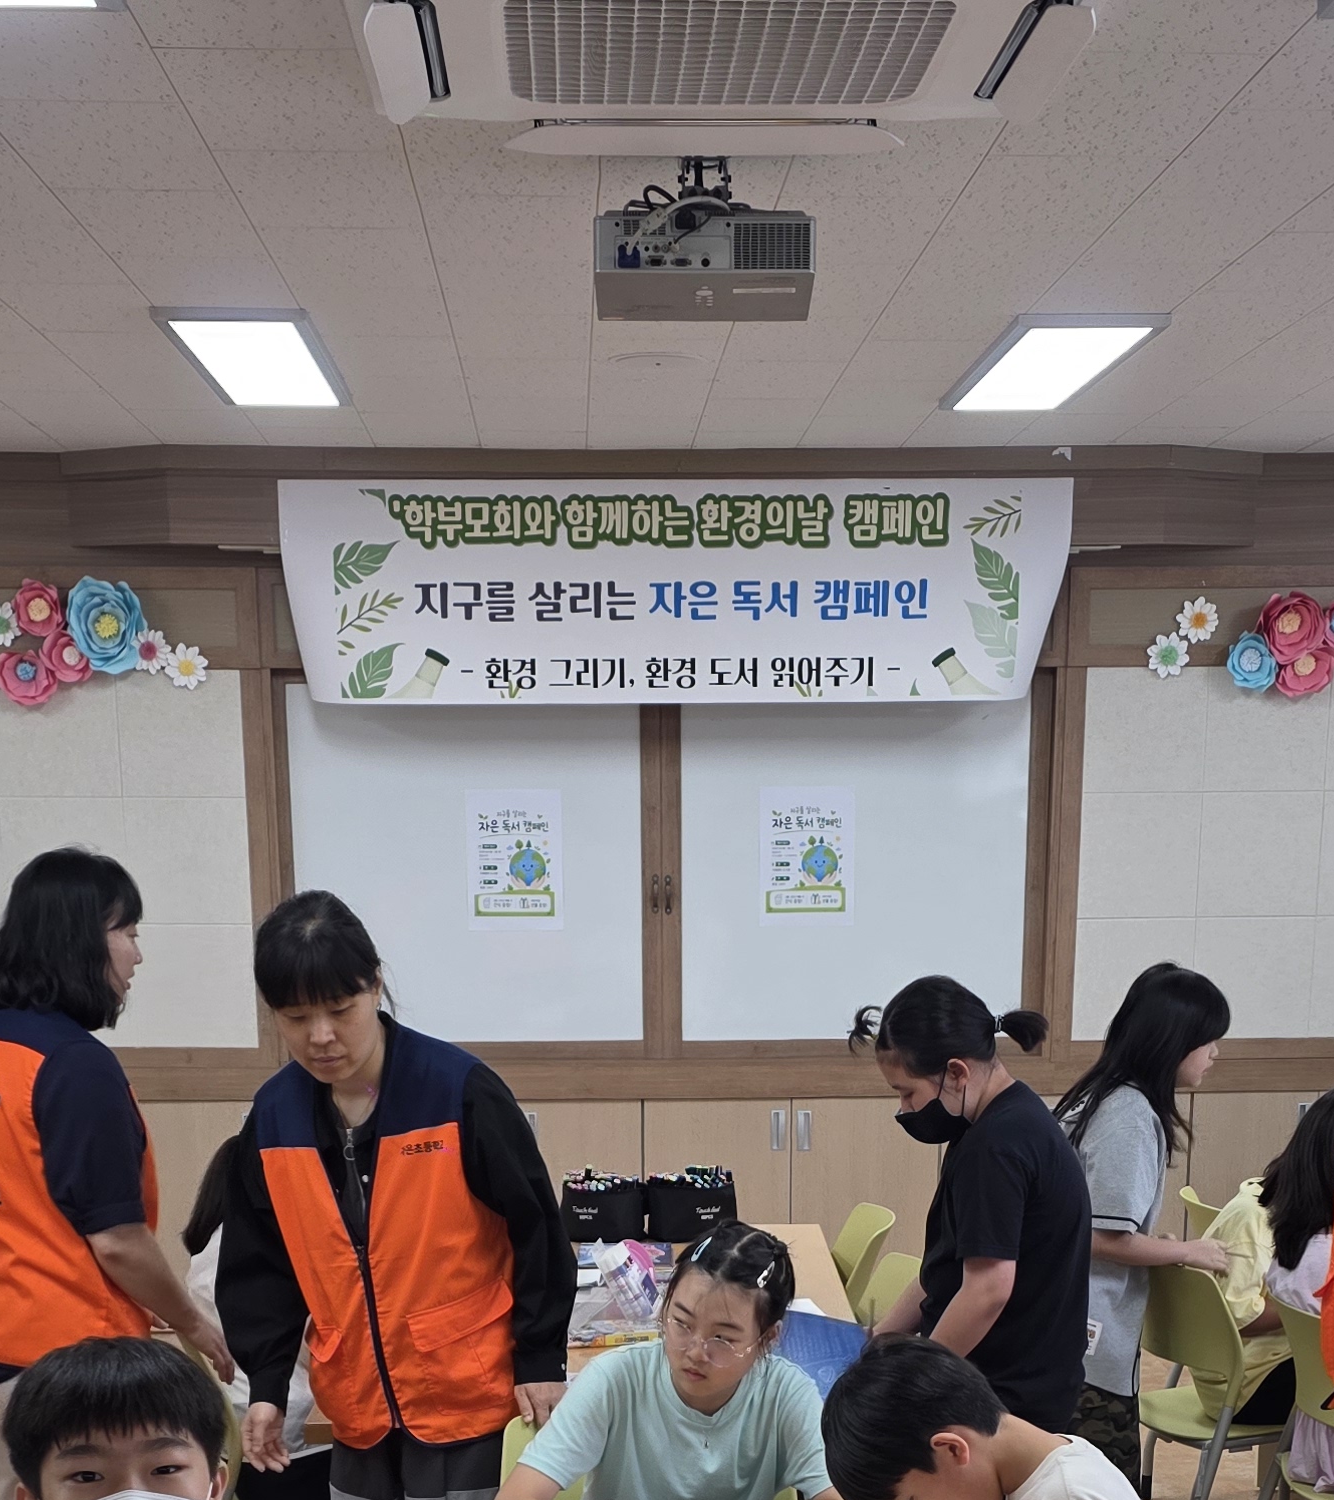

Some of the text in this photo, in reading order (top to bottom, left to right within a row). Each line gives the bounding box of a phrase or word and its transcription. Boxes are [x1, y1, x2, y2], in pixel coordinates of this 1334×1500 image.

[564, 497, 690, 544] 함께하는
[699, 496, 829, 543] 환경의날
[846, 496, 946, 542] 캠페인
[414, 578, 929, 622] 지구를 살리는 자은 독서 캠페인
[484, 657, 537, 689] 환경
[549, 657, 635, 689] 그리기,
[645, 656, 696, 689] 환경
[708, 656, 758, 687] 도서
[771, 656, 875, 688] 읽어주기
[478, 819, 549, 833] 자은 독서 캠페인
[772, 816, 842, 830] 자은 독서 캠페인
